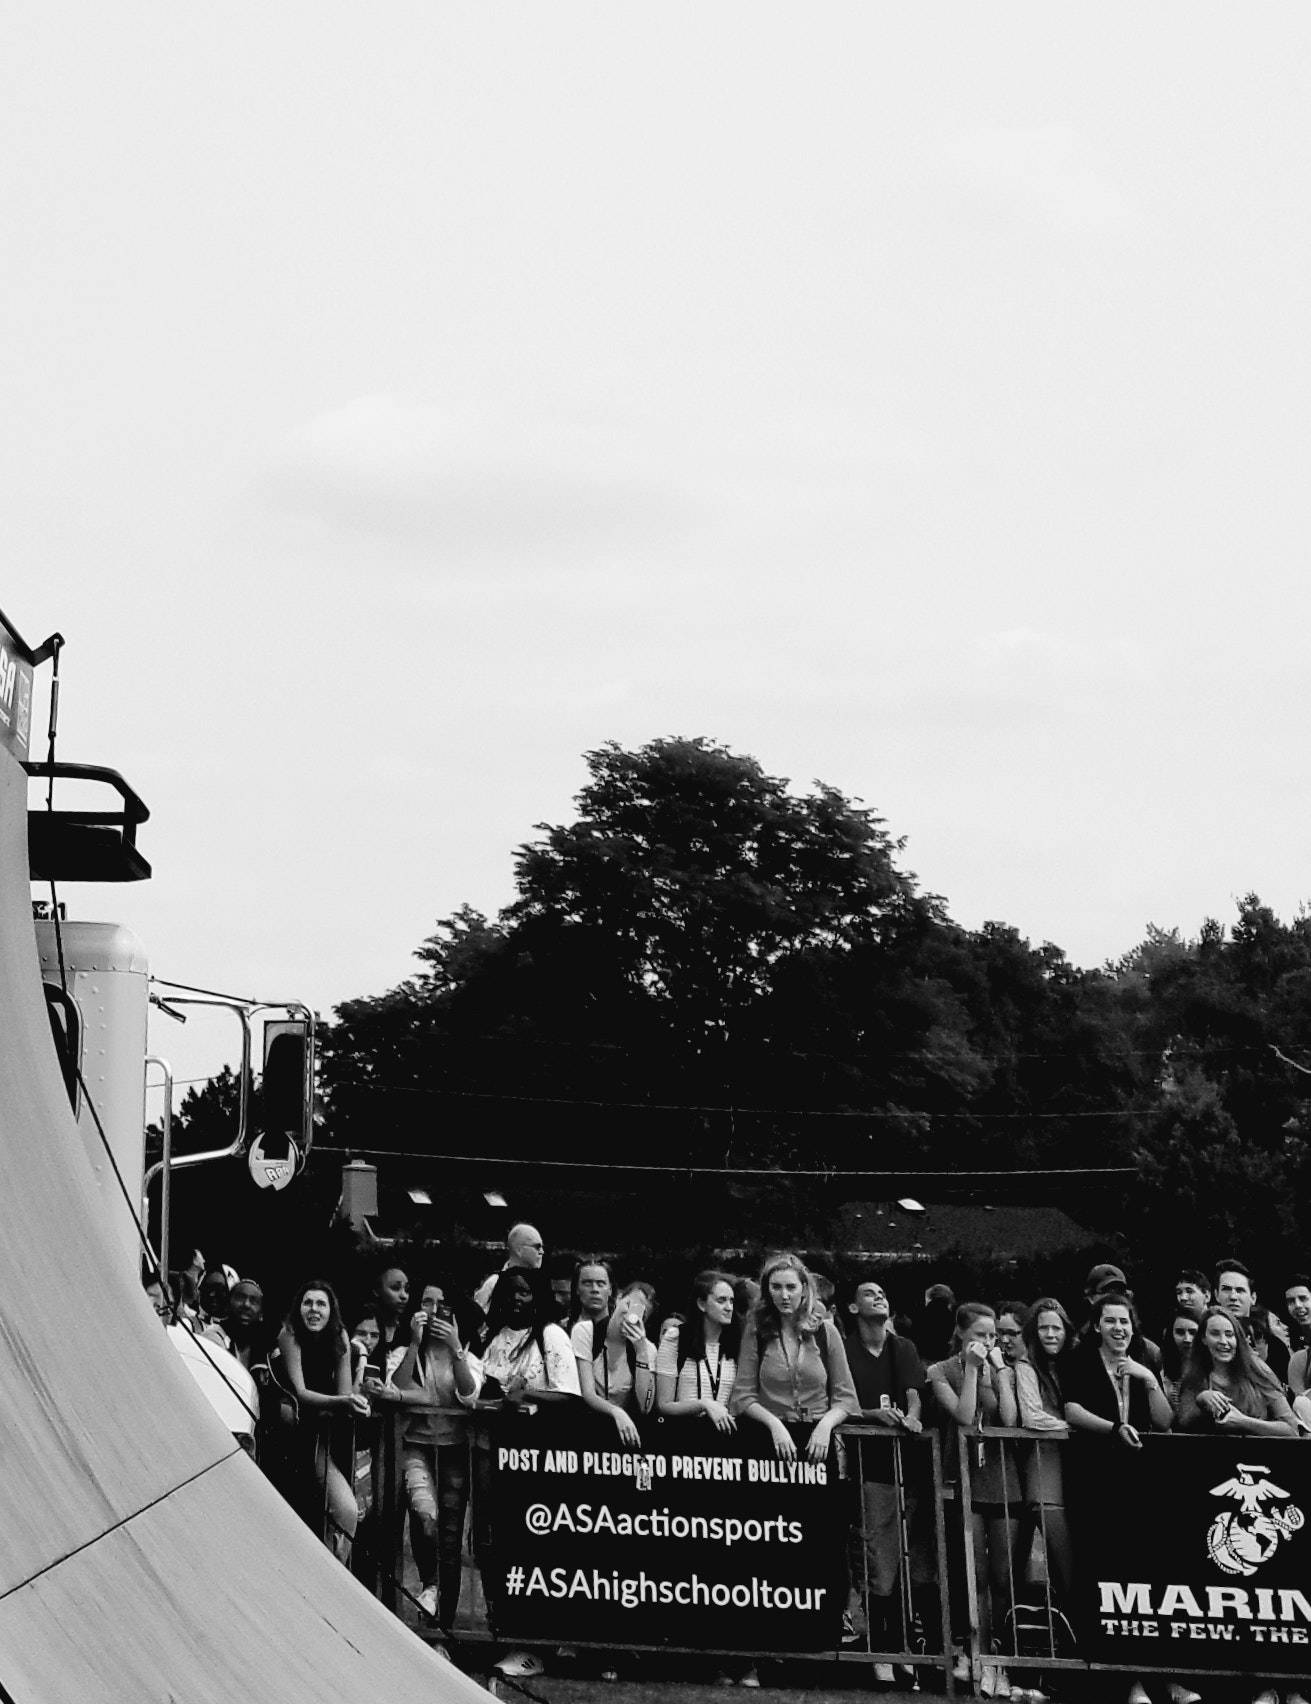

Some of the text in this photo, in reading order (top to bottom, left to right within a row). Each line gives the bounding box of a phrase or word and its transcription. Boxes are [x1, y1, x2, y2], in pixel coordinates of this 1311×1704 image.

[498, 1447, 540, 1473] POST
[543, 1449, 578, 1474] AND
[645, 1454, 667, 1478] TO
[671, 1455, 743, 1482] PREVENT
[747, 1458, 828, 1486] BULLYING
[525, 1502, 803, 1546] @ASAactionsports
[505, 1565, 827, 1611] #ASAhighschooltour
[1100, 1619, 1310, 1645] THE FEW. THE
